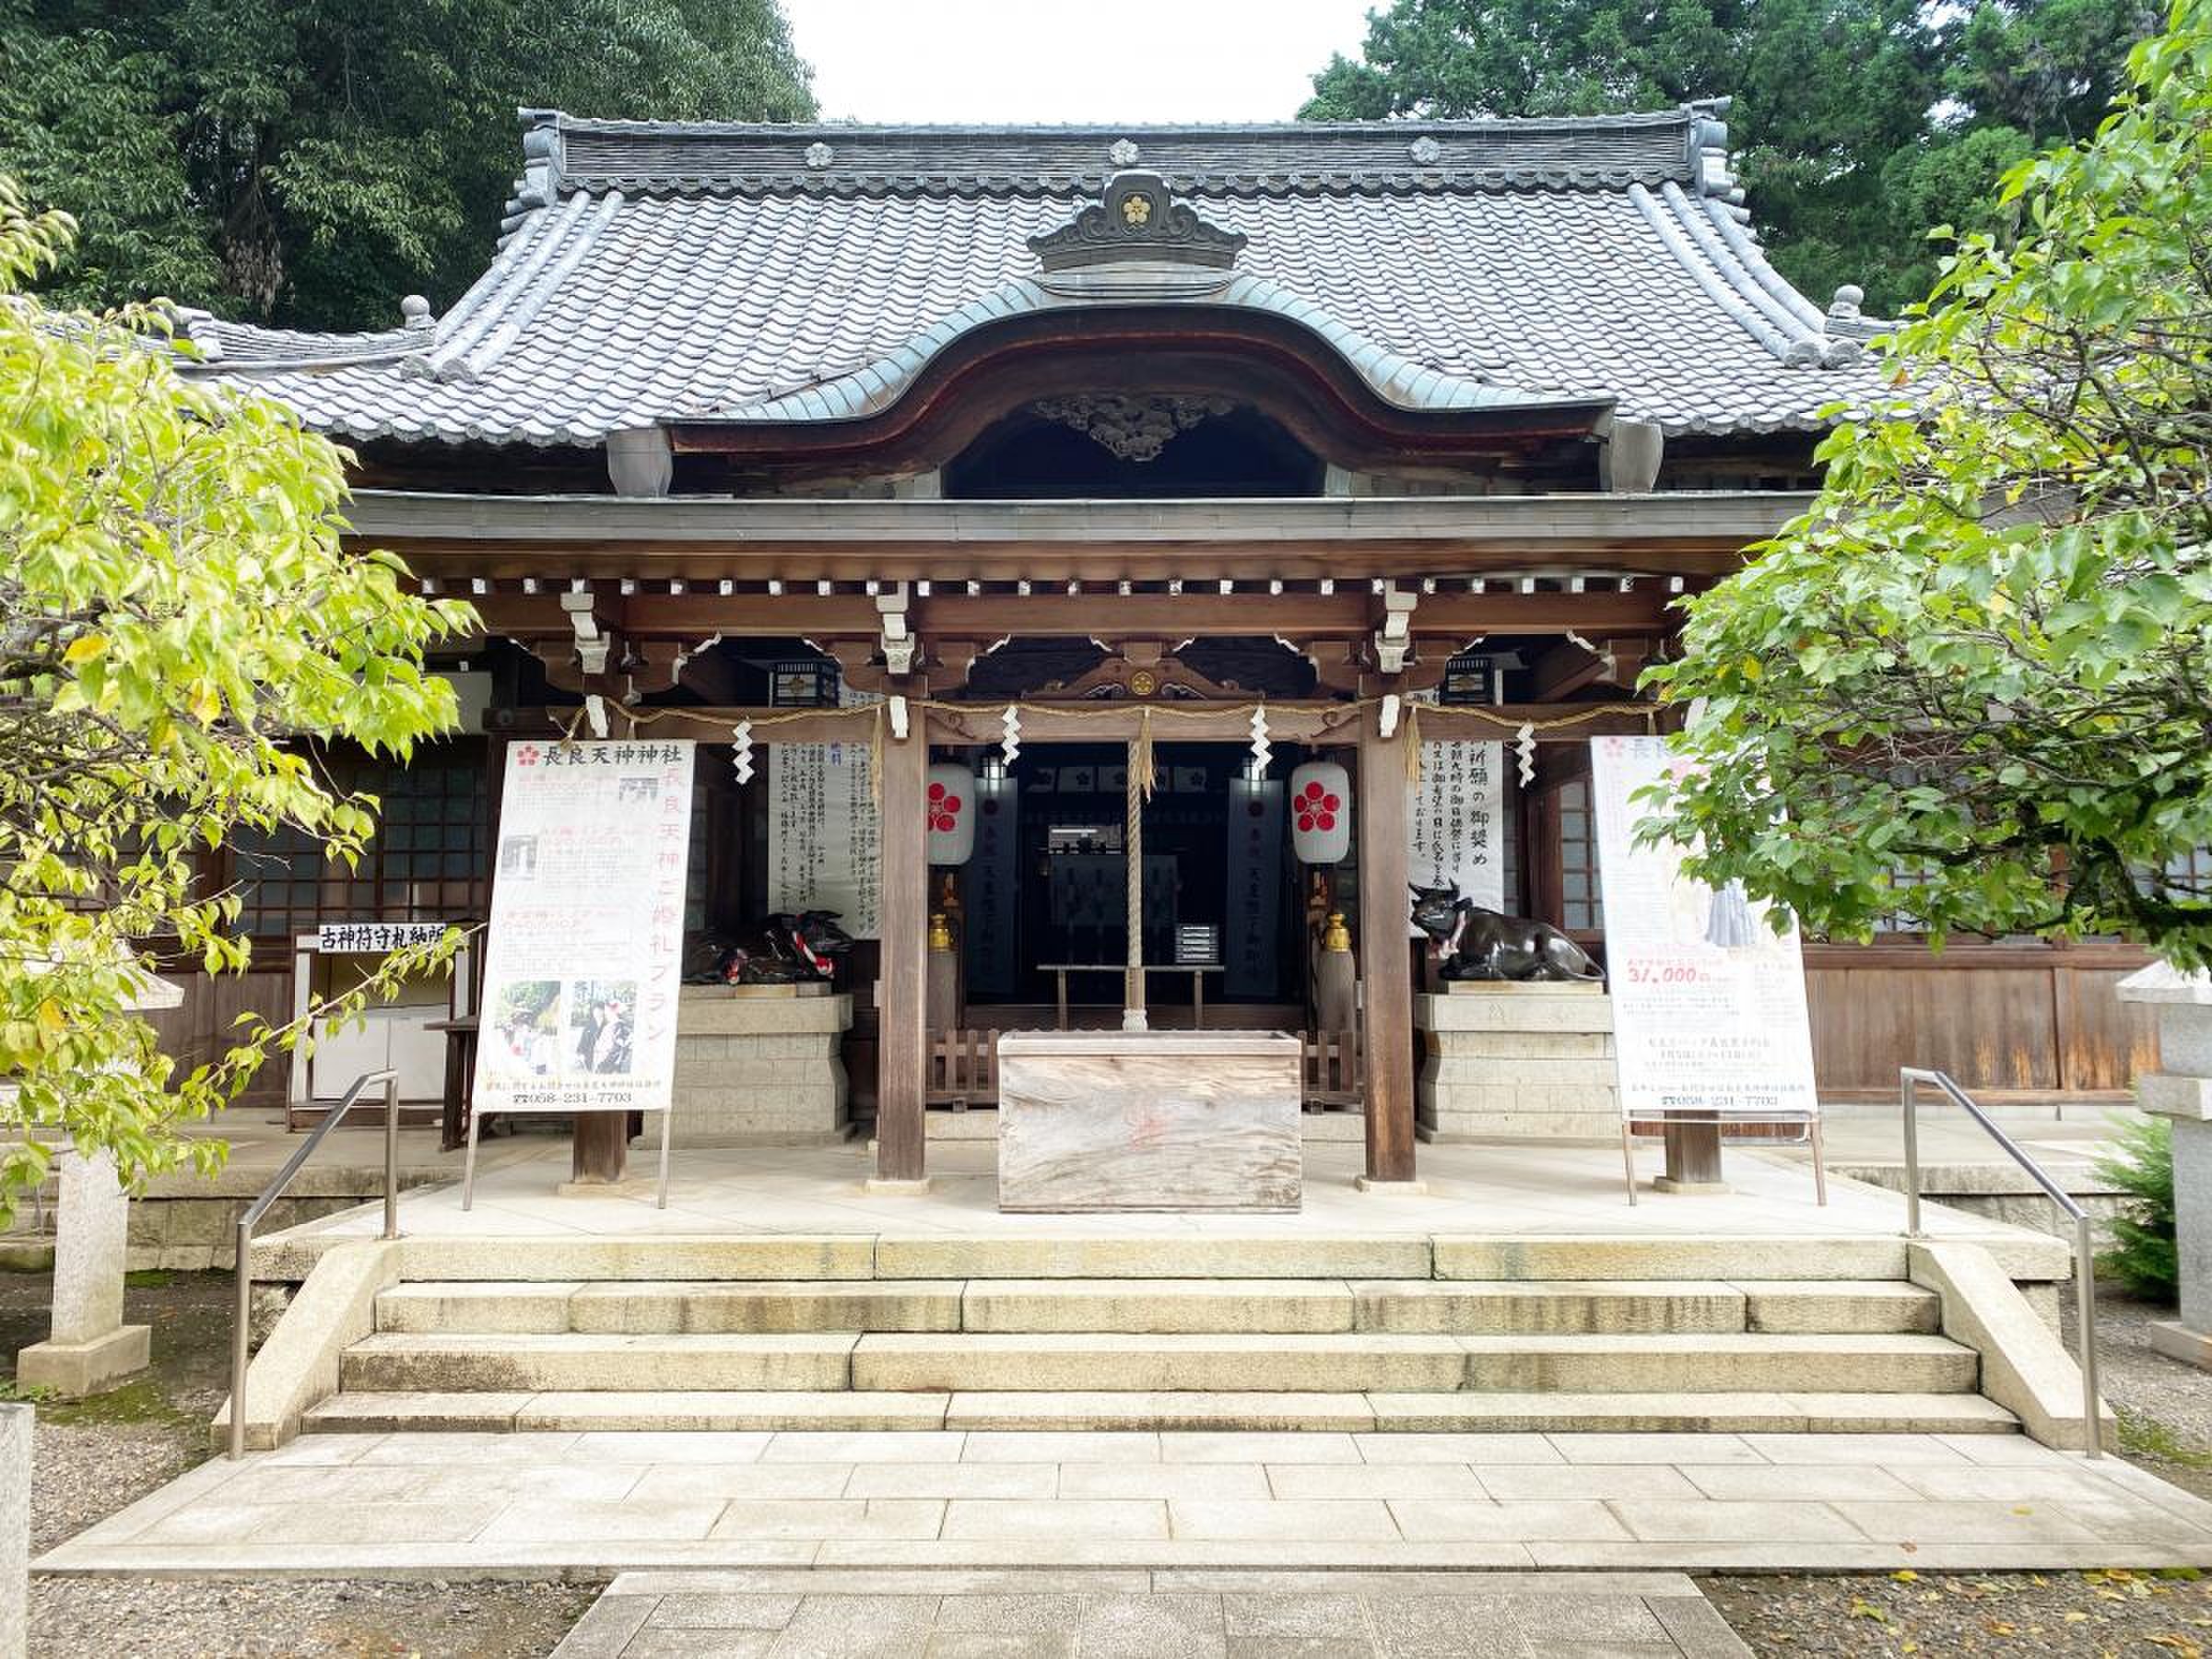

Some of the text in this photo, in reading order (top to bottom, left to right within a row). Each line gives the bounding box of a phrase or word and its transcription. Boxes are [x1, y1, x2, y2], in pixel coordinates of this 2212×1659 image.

[542, 744, 683, 765] 長良天神神社
[322, 925, 443, 949] 古神符守札納所
